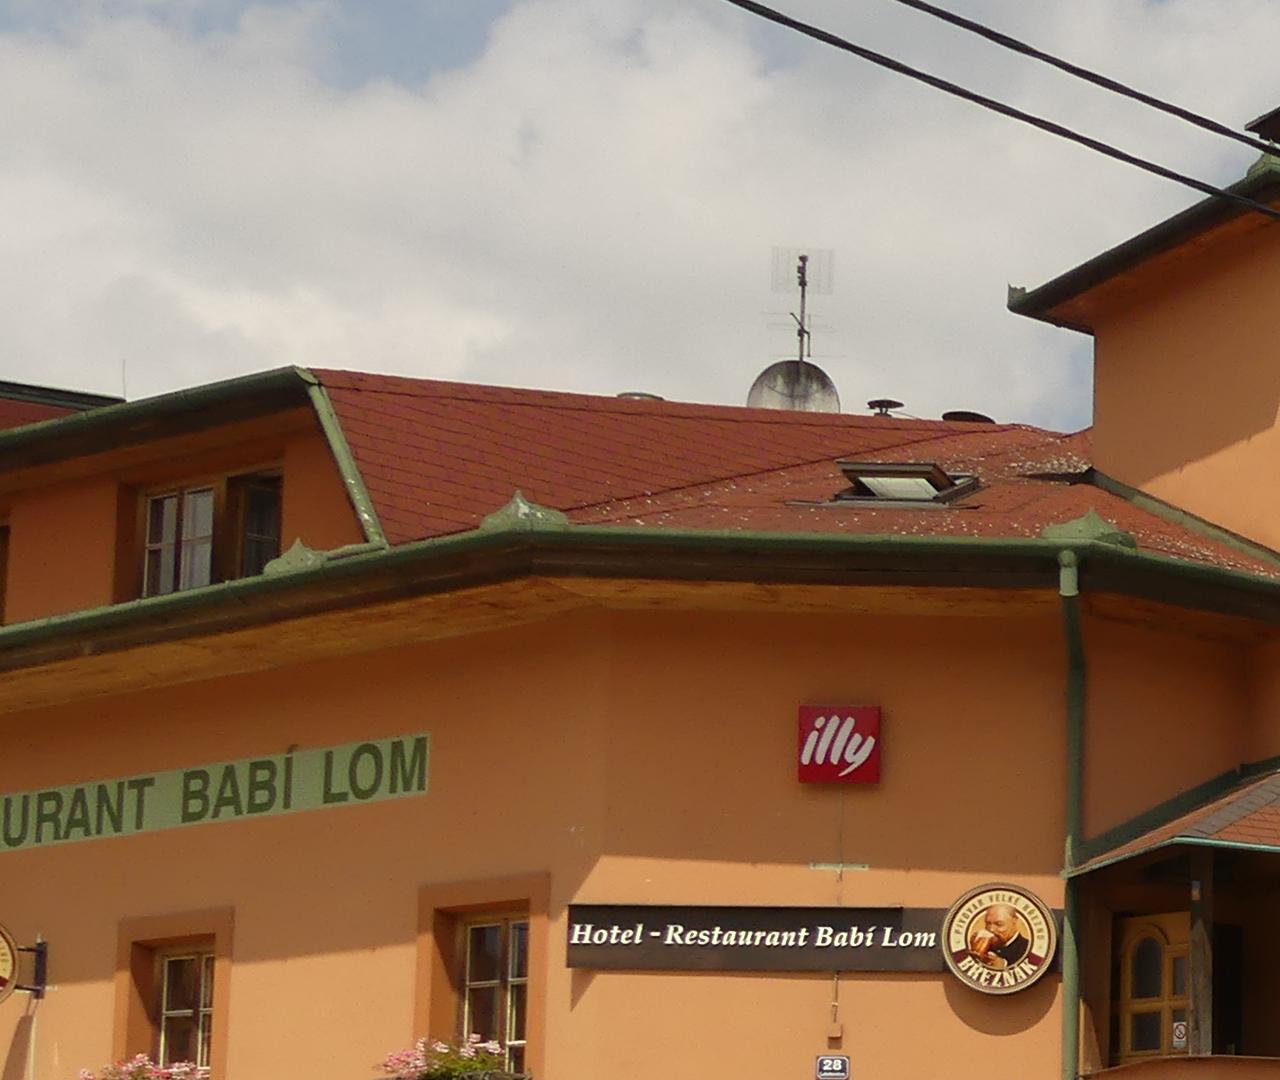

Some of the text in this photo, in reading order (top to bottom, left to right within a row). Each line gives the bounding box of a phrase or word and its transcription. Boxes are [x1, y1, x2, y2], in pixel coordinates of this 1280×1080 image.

[801, 715, 876, 777] illy
[181, 744, 299, 824] BABÍ
[323, 736, 429, 804] LOM
[570, 923, 643, 945] Hotel
[664, 924, 810, 946] Restaurant
[815, 926, 877, 947] Babí
[881, 927, 936, 947] Lom
[823, 1059, 842, 1070] 28
